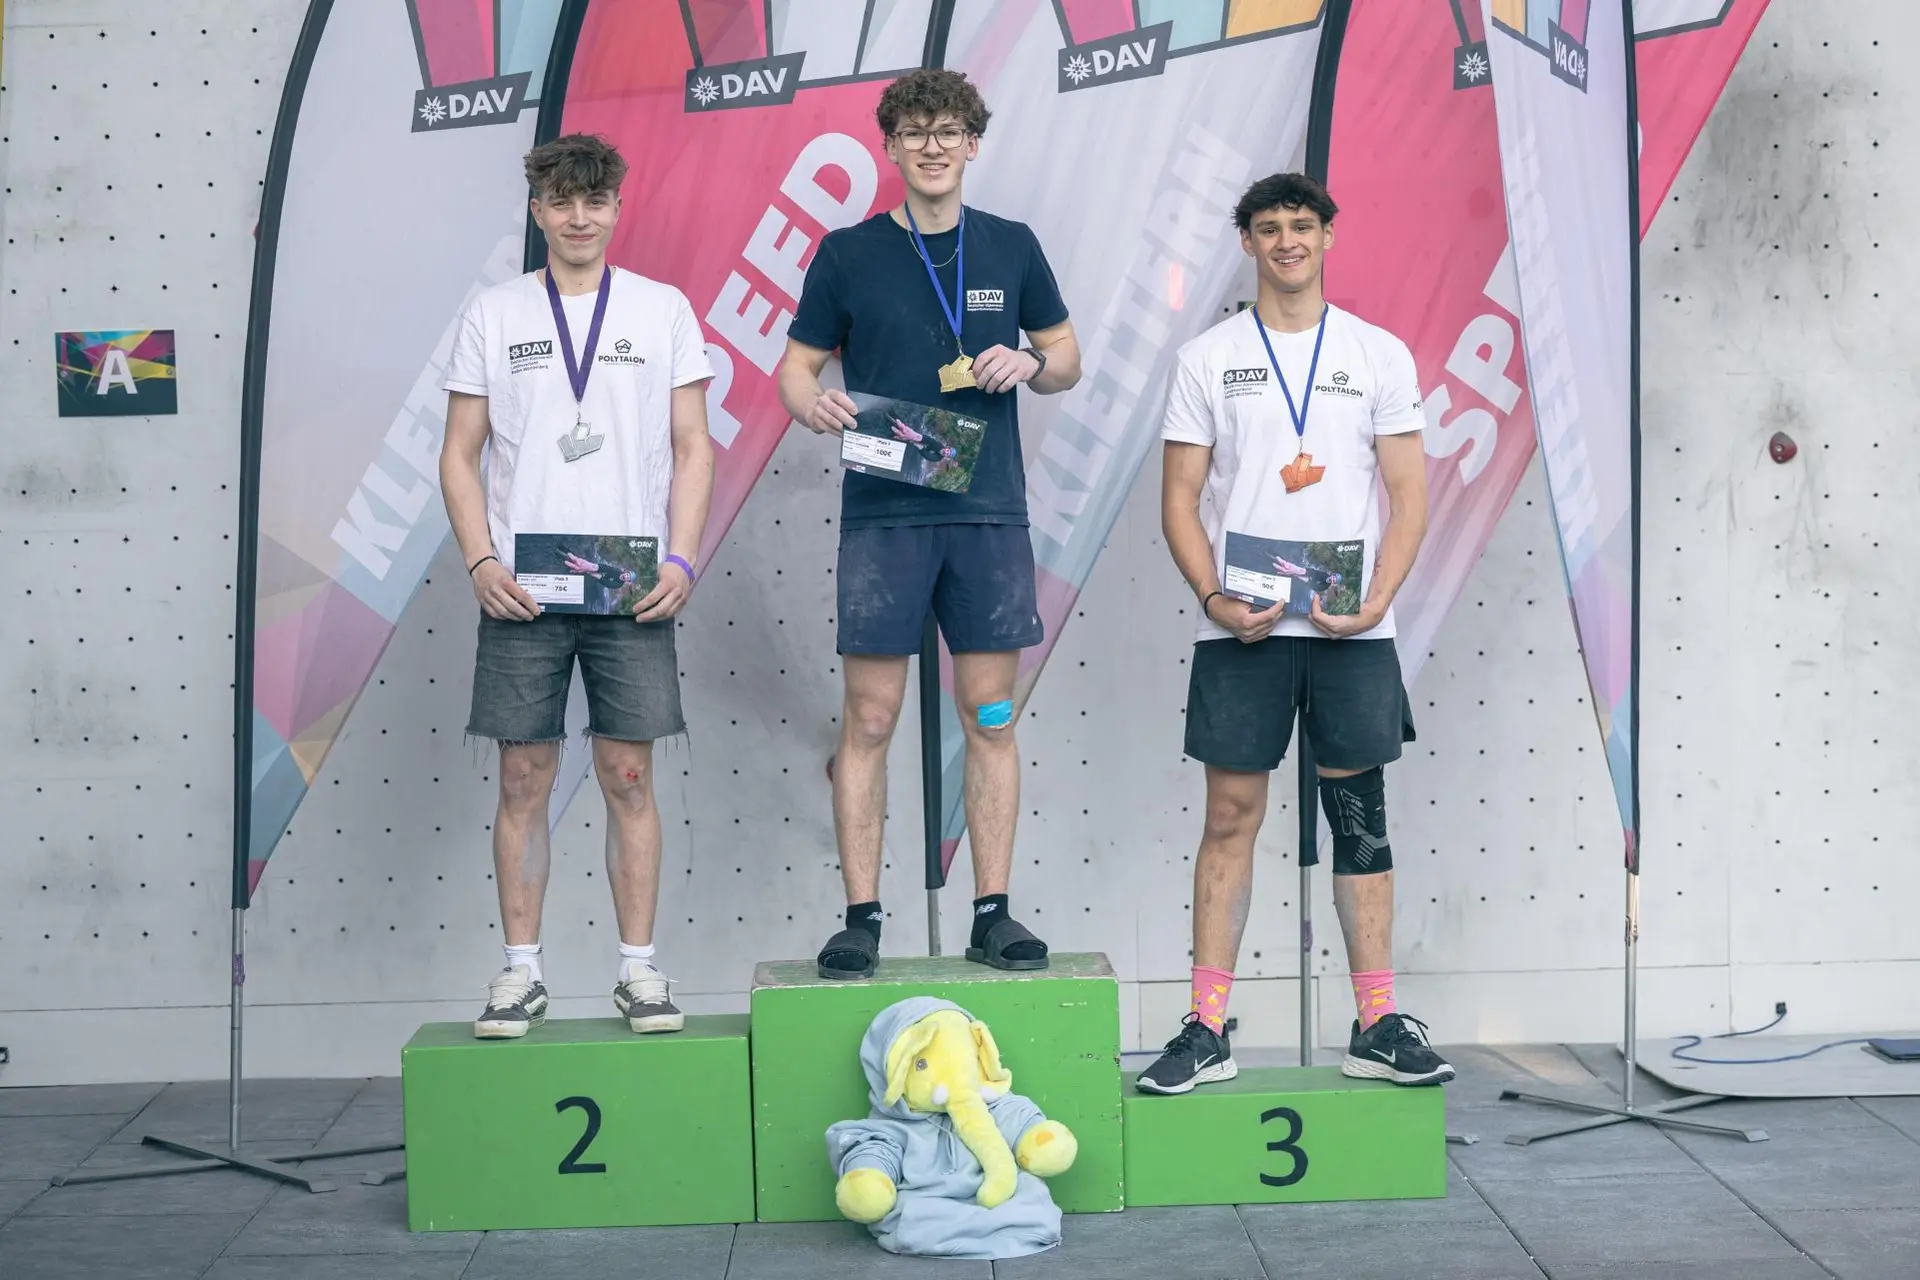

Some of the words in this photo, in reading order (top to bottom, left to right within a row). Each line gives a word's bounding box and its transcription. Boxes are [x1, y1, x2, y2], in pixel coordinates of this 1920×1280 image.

[1092, 38, 1157, 76] DAV
[720, 67, 788, 99] DAV
[448, 87, 513, 119] DAV
[704, 132, 878, 450] PEED
[979, 292, 1002, 301] DAV
[521, 342, 551, 356] DAV
[598, 355, 646, 365] POLYTALON
[97, 350, 138, 395] A
[1235, 369, 1267, 382] DAV
[1315, 385, 1363, 397] POLYTALON
[964, 420, 981, 430] DAV
[555, 1096, 606, 1174] 2
[1259, 1107, 1309, 1187] 3
